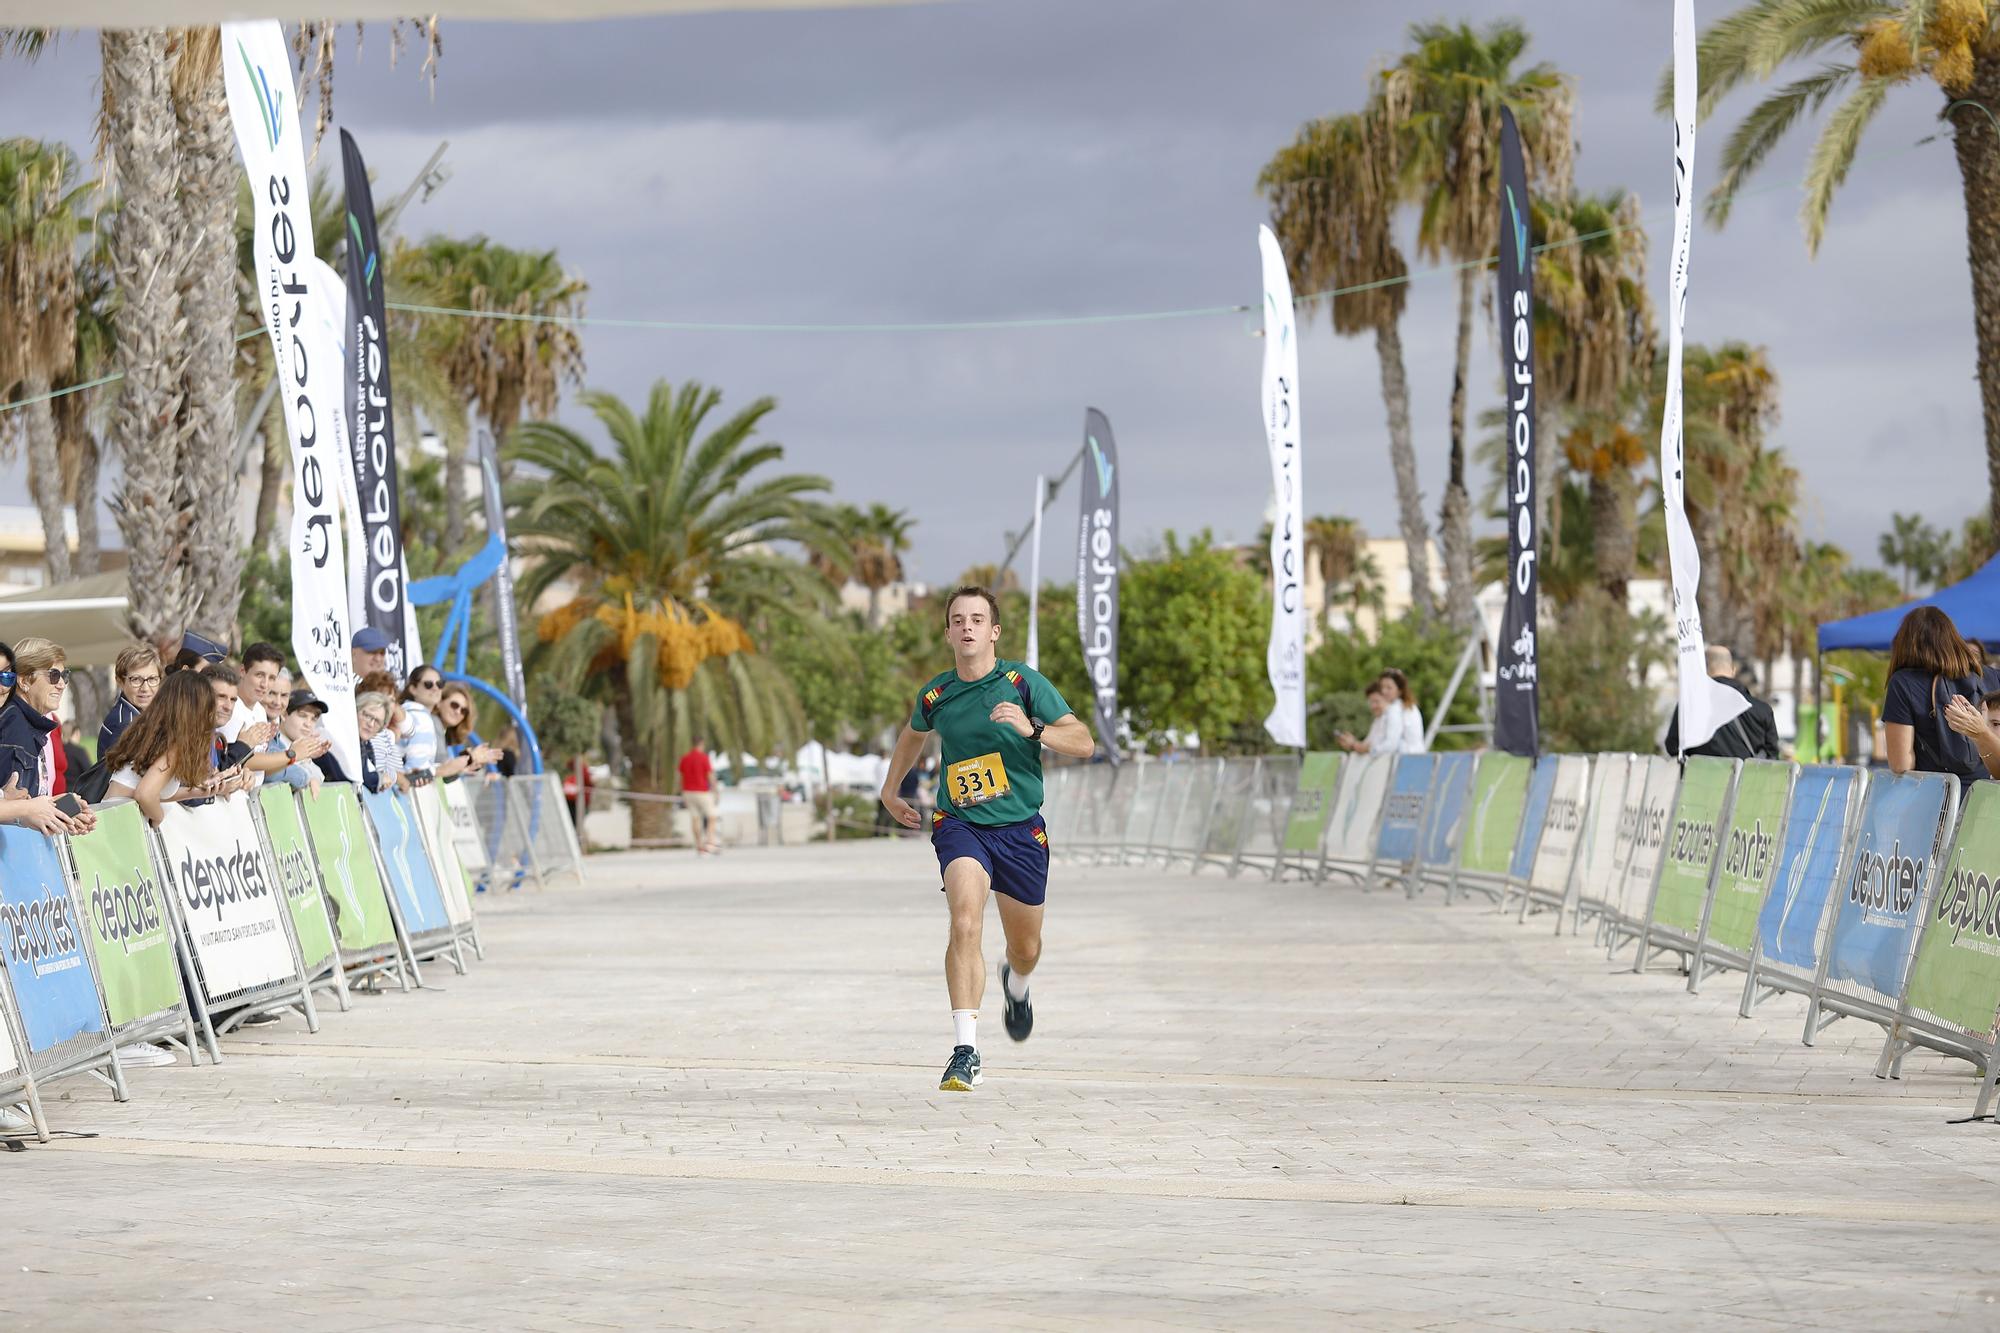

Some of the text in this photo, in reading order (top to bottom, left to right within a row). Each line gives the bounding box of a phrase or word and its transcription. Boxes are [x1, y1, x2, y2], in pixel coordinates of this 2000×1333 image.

[956, 768, 995, 796] 331
[181, 838, 268, 922] deportes
[1849, 833, 1924, 924] deportes
